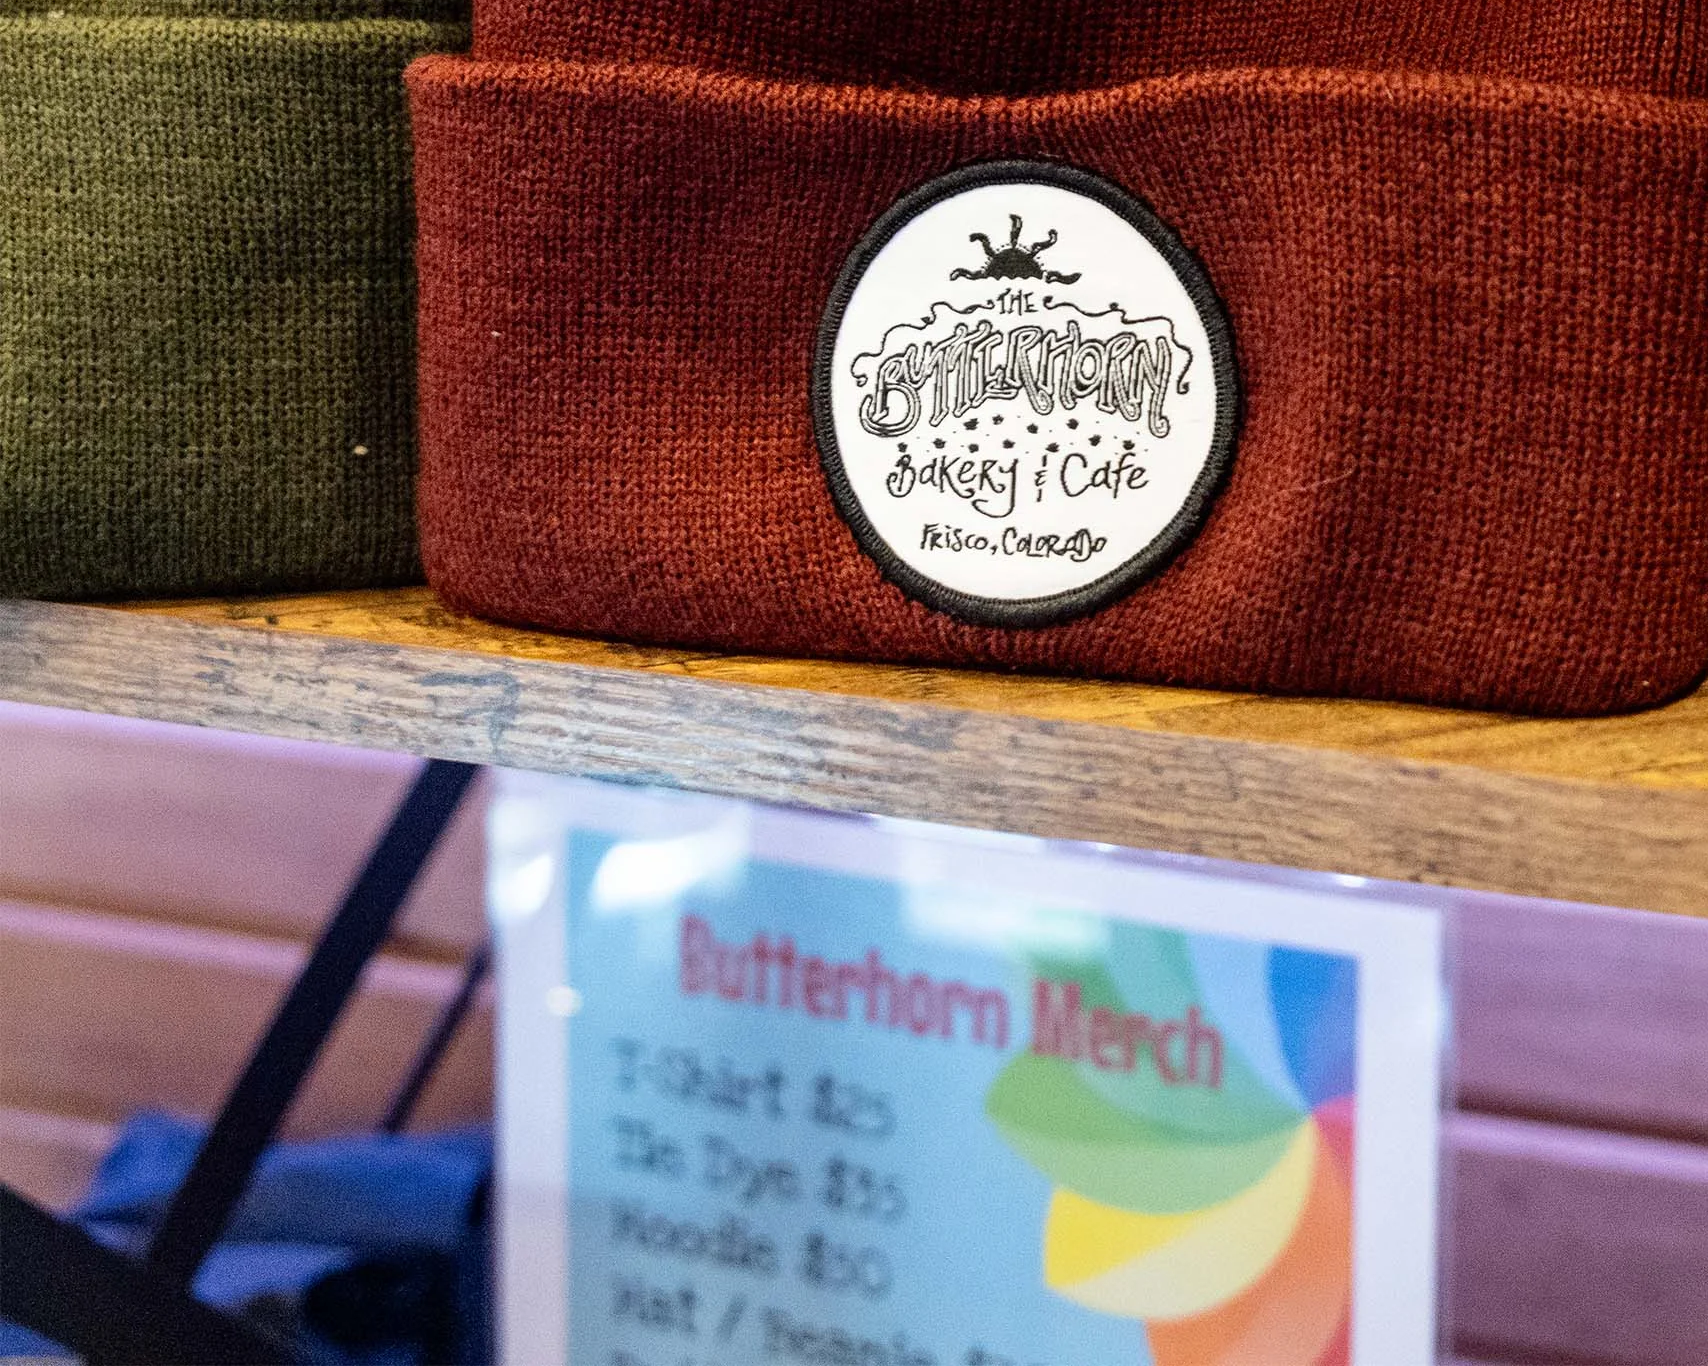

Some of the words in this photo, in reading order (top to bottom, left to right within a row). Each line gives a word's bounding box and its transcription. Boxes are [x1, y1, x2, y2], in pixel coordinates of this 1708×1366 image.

[997, 287, 1037, 316] THE
[1060, 452, 1149, 499] Cafe
[679, 914, 1009, 1049] Butterhorn
[1032, 977, 1224, 1090] Merch
